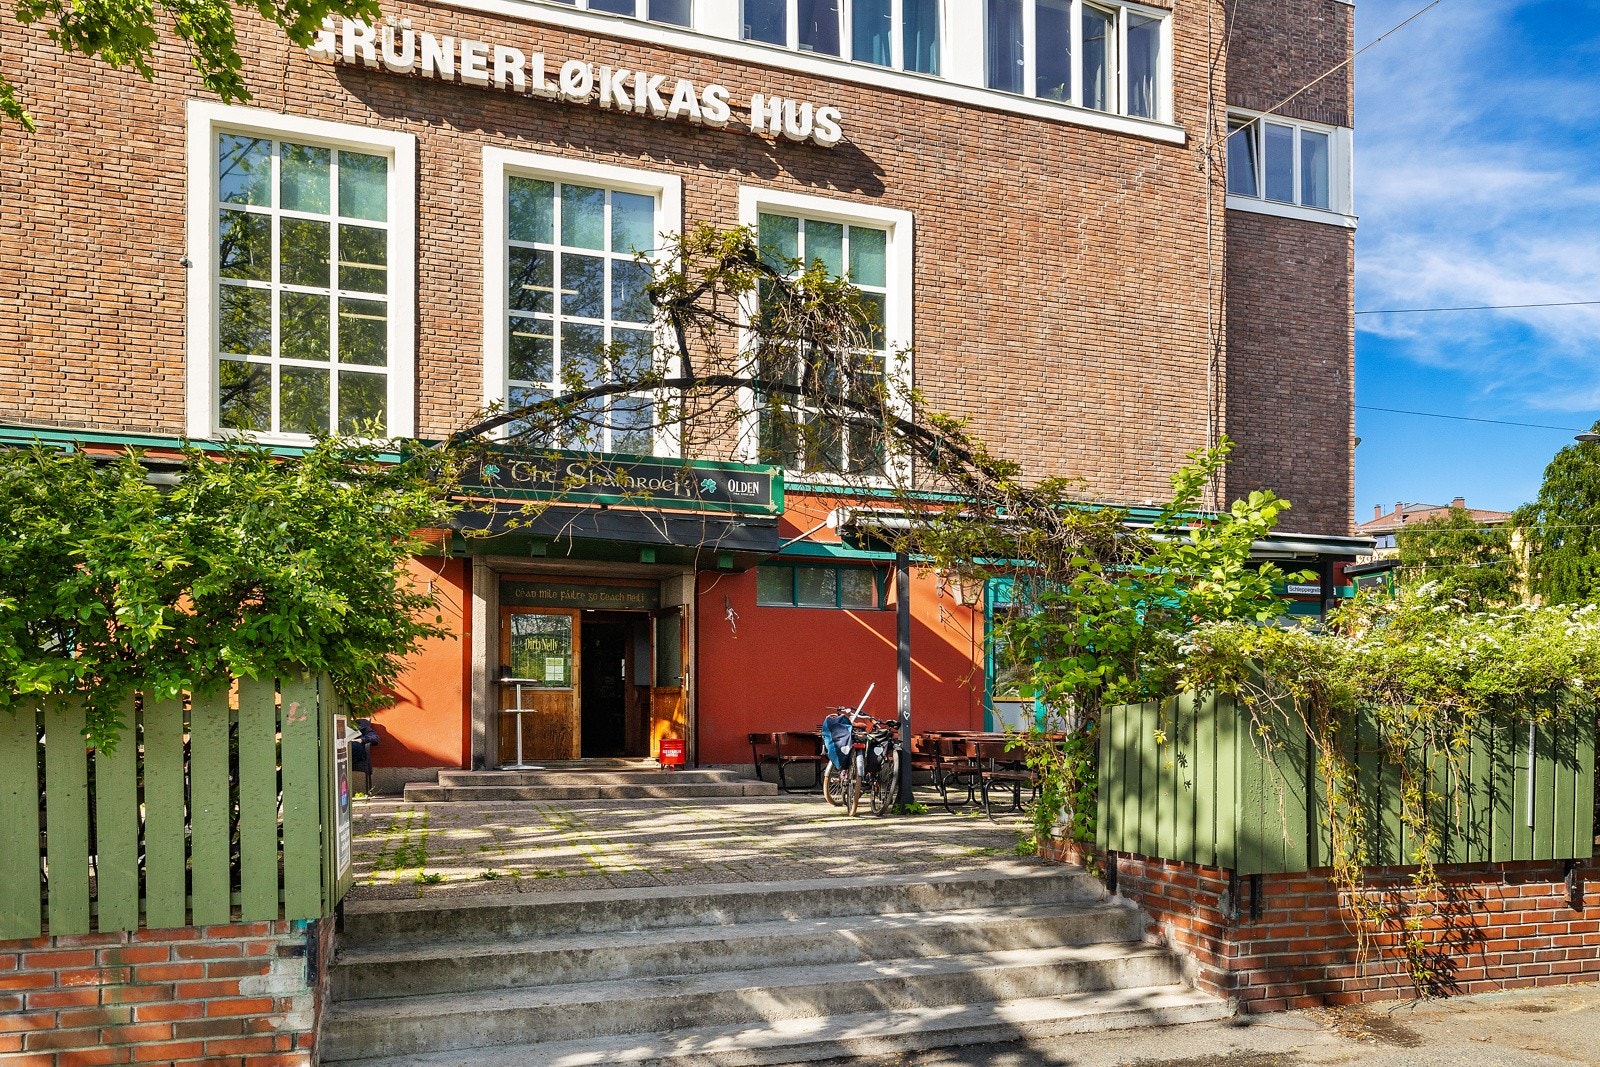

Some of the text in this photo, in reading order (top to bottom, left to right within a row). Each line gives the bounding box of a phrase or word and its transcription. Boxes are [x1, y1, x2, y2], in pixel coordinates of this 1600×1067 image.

[305, 14, 842, 147] GRÜNERLØKKAS HUS
[727, 478, 760, 495] OLDEN
[1288, 585, 1320, 594] Schleppegrell
